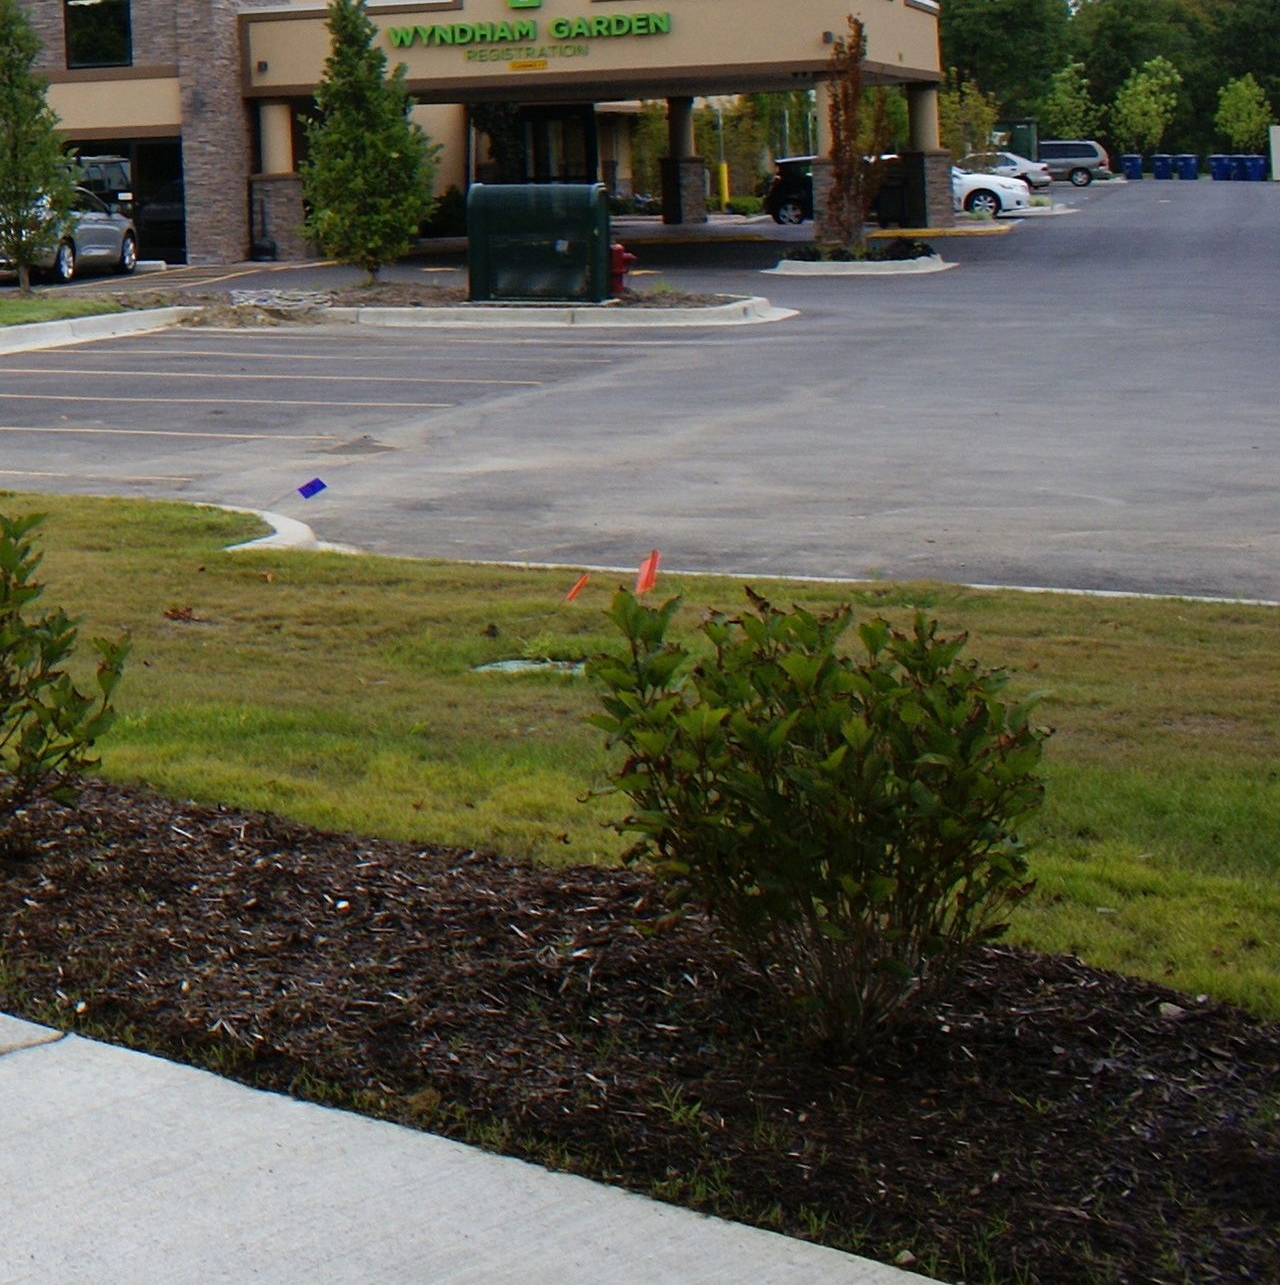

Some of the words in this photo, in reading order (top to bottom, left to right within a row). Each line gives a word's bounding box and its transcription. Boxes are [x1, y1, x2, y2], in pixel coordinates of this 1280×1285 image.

[390, 19, 536, 48] WYNDHAM
[549, 12, 671, 40] GARDEN
[465, 44, 589, 62] REGISTRATION
